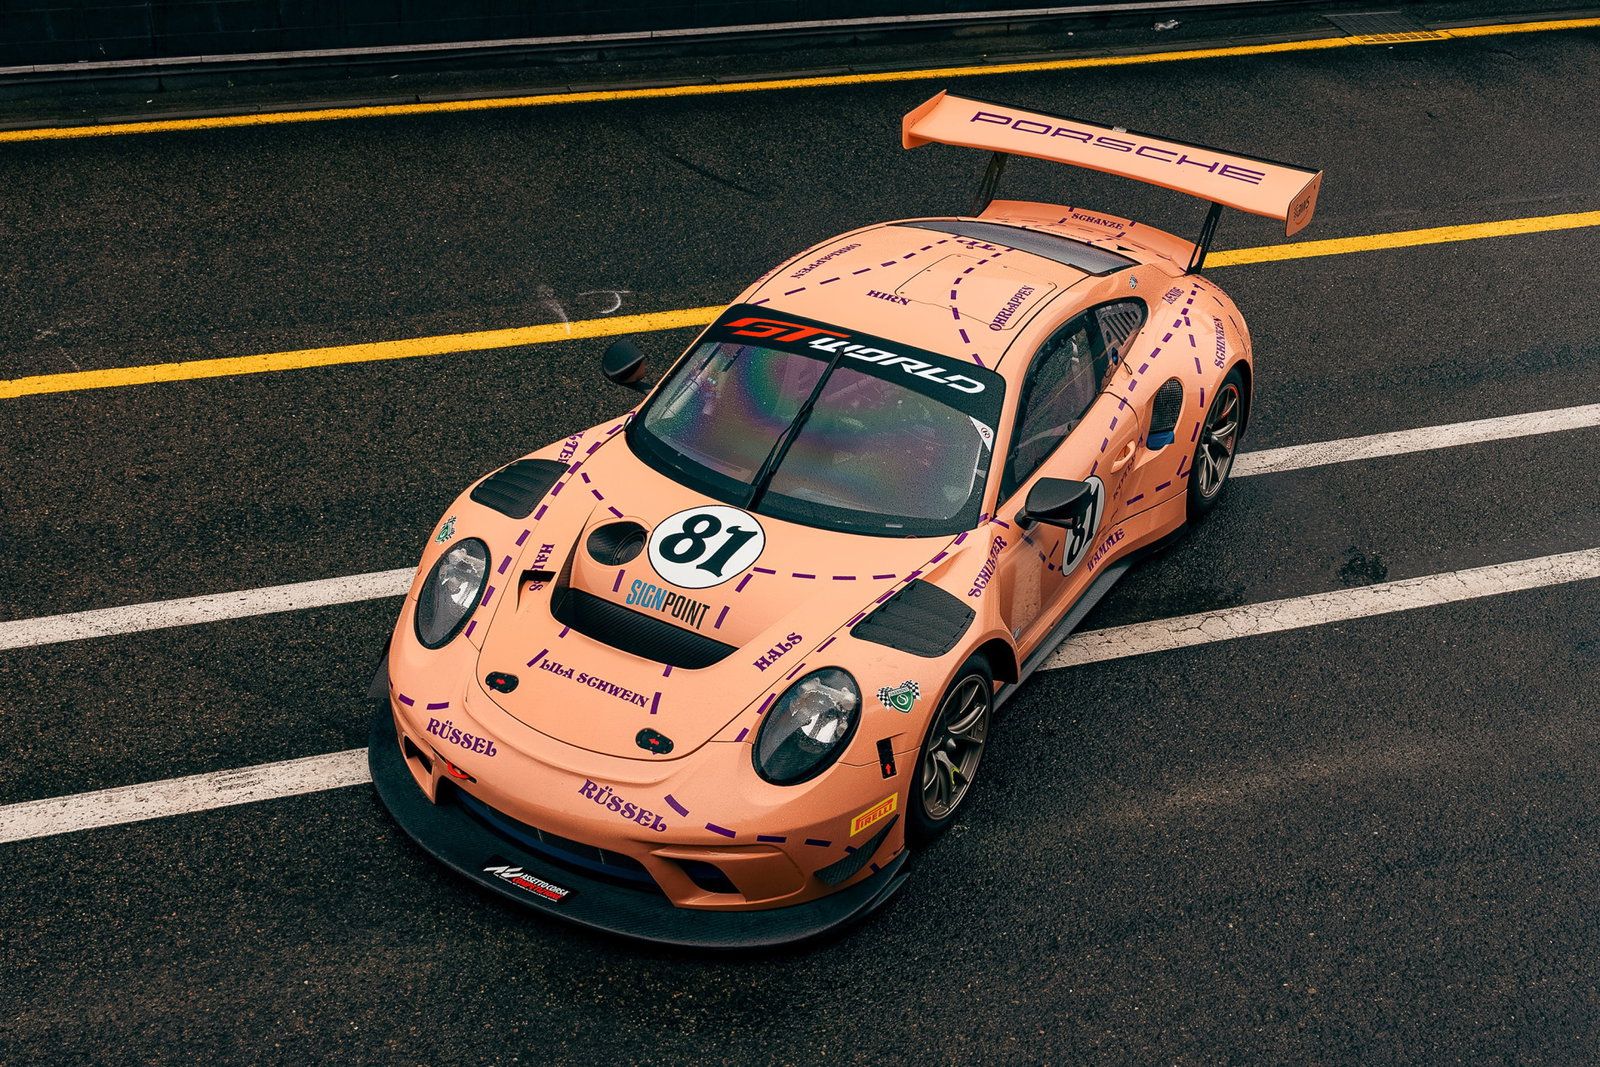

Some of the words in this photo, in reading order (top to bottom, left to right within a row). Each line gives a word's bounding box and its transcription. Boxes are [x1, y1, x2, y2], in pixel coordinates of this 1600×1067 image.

[970, 111, 1266, 185] PORSCHE
[1071, 212, 1124, 230] SCHANZE
[866, 289, 912, 306] HIRN
[989, 285, 1036, 331] OHRLAPPEN
[722, 317, 851, 343] GT
[808, 337, 985, 394] WORLD
[658, 514, 758, 577] 81
[968, 536, 1007, 597] SCHULTER
[626, 578, 710, 630] SIGNPOINT
[752, 632, 803, 672] HALS
[538, 659, 575, 677] LILA
[579, 672, 650, 707] SCHWEIN
[426, 717, 498, 758] RÜSSEL
[578, 779, 668, 832] RÜSSEL
[854, 798, 894, 831] PIRELLI
[520, 874, 548, 889] ASSETTO
[547, 884, 569, 897] CORSA
